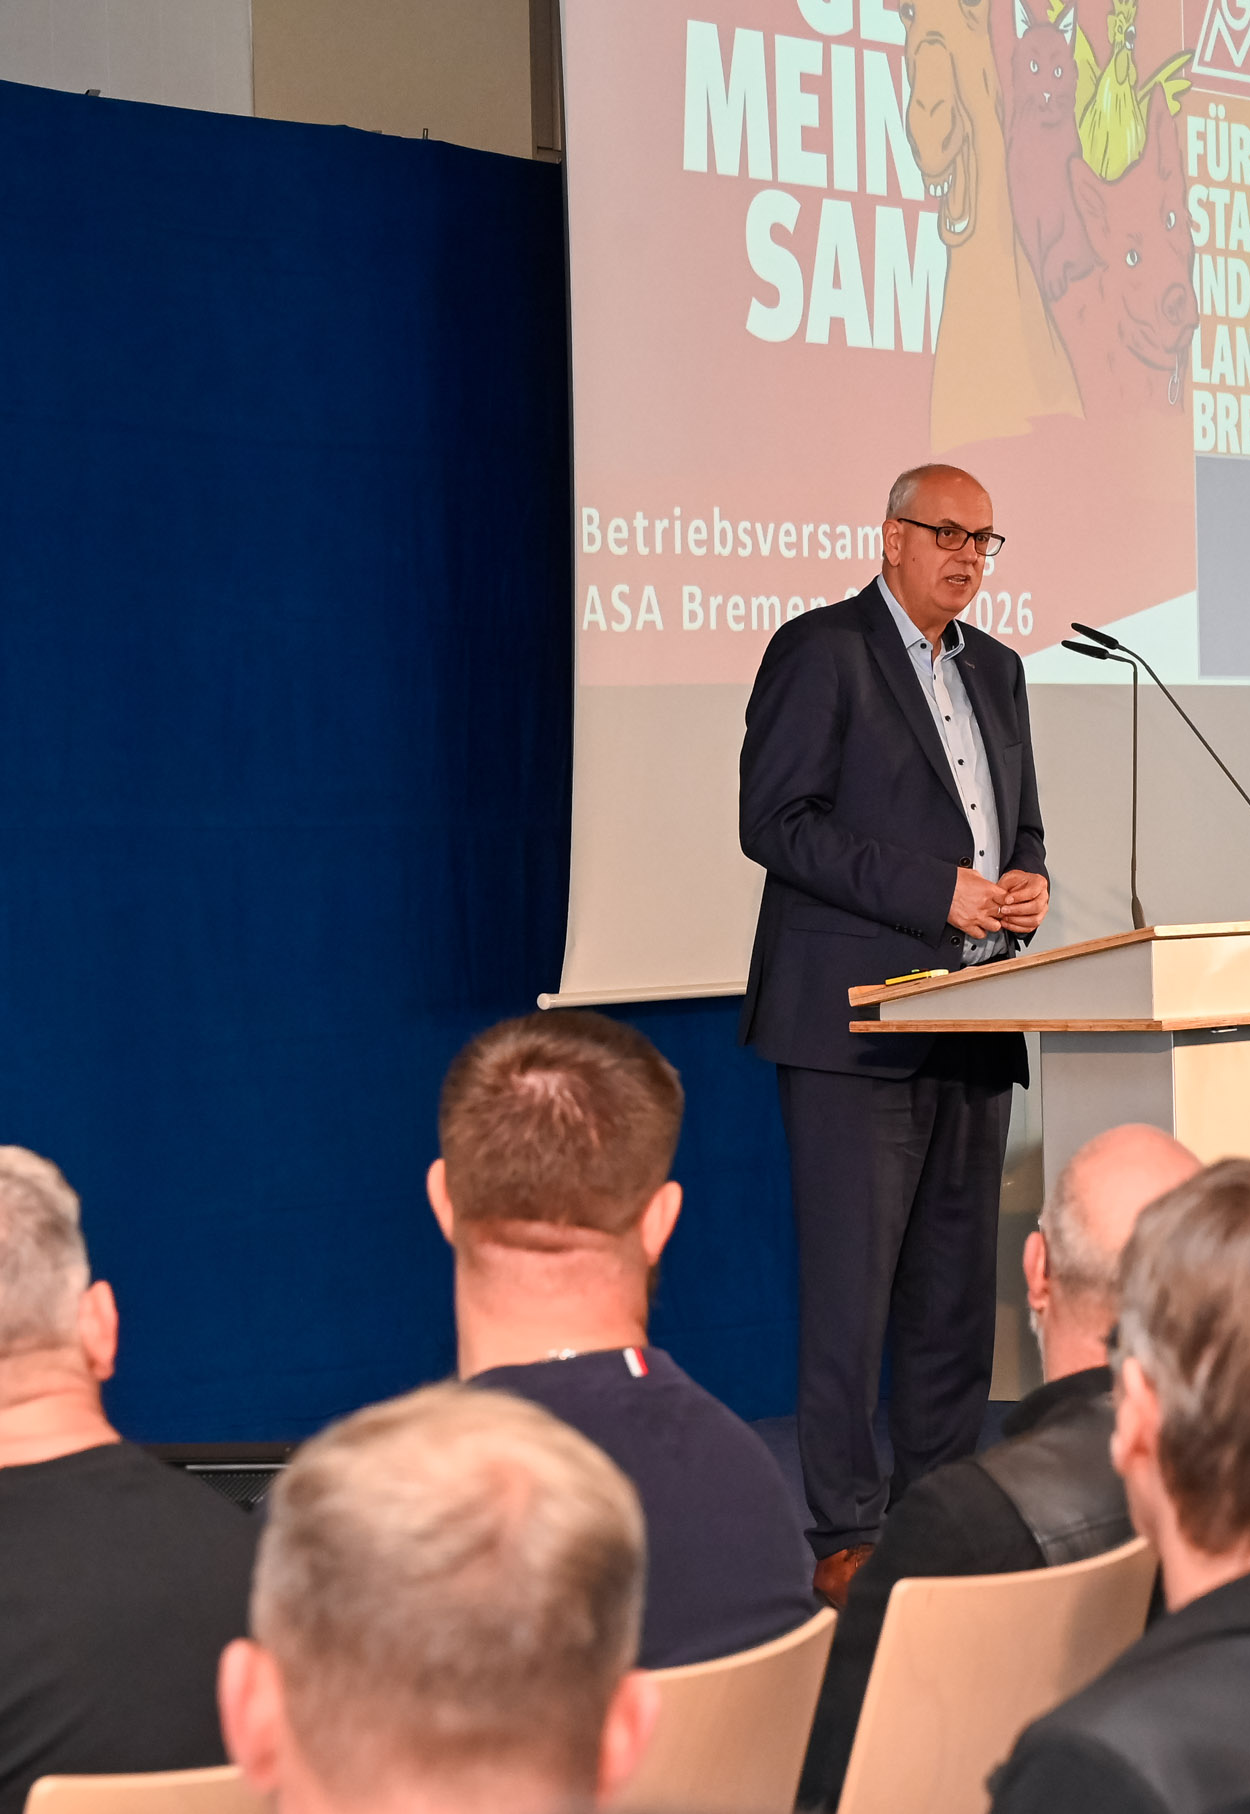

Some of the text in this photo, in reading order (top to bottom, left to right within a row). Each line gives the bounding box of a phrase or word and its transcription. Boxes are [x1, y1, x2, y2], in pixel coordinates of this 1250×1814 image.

[683, 19, 926, 202] MEIN
[745, 189, 948, 355] SAM
[581, 506, 995, 576] Betriebsversam
[582, 583, 665, 633] ASA
[958, 590, 1034, 636] 026
